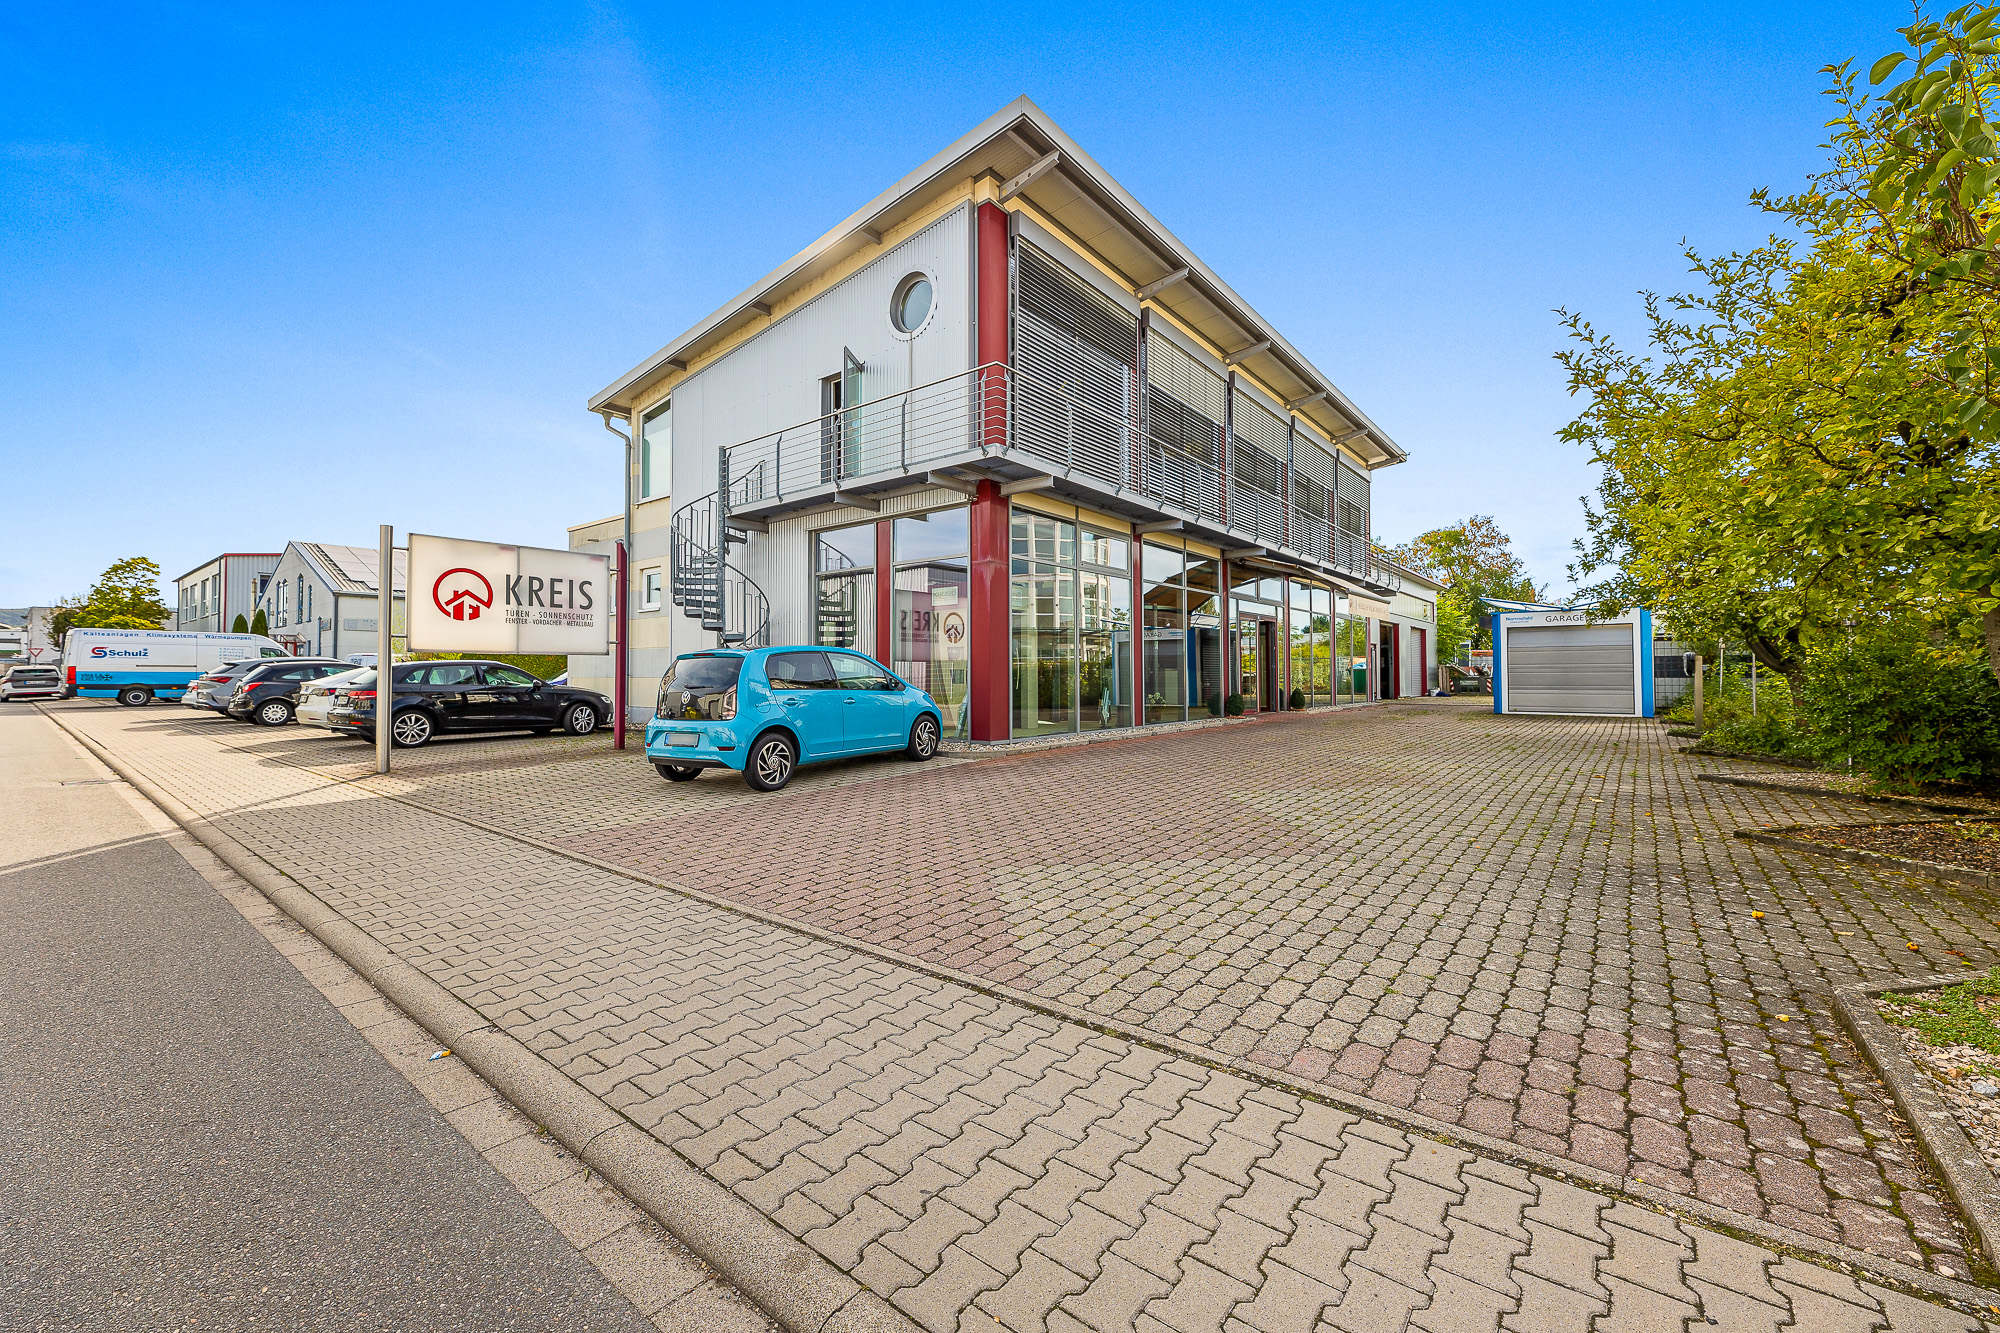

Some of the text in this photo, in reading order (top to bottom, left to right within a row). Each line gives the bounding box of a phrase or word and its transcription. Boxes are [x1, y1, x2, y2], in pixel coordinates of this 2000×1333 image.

[505, 573, 593, 610] KREIS
[505, 607, 530, 617] TÜREN
[538, 611, 594, 621] SONNENSCHUTZ
[505, 617, 528, 625] FENSTER
[566, 620, 594, 628] METALLBAU
[146, 632, 198, 640] Klimasysteme
[108, 649, 149, 657] Schulz
